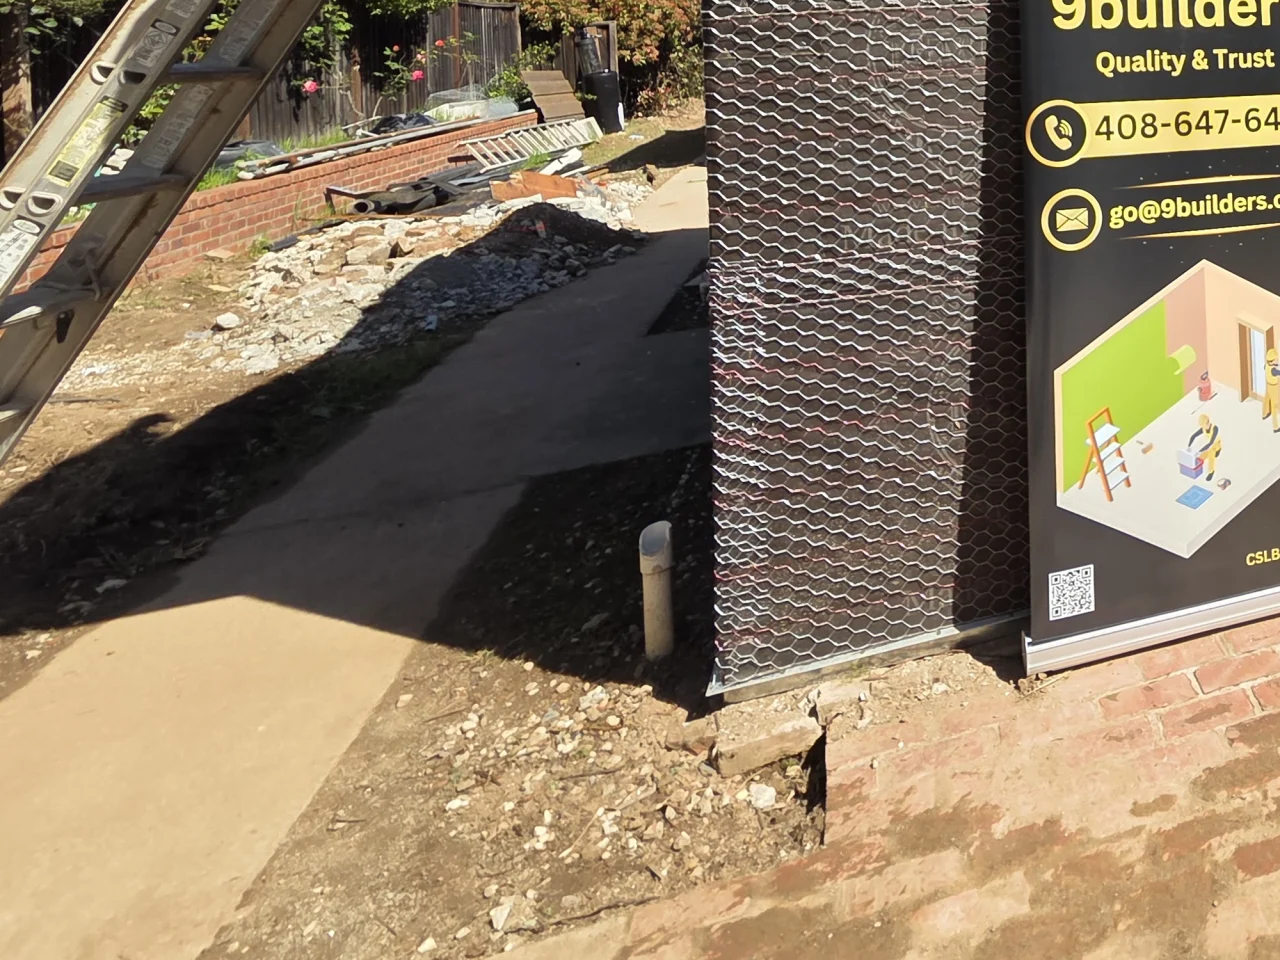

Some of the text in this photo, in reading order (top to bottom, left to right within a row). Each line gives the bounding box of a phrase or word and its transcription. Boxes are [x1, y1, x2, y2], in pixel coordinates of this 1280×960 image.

[1095, 47, 1275, 78] Quality & Trust
[1246, 547, 1280, 566] CSLB
